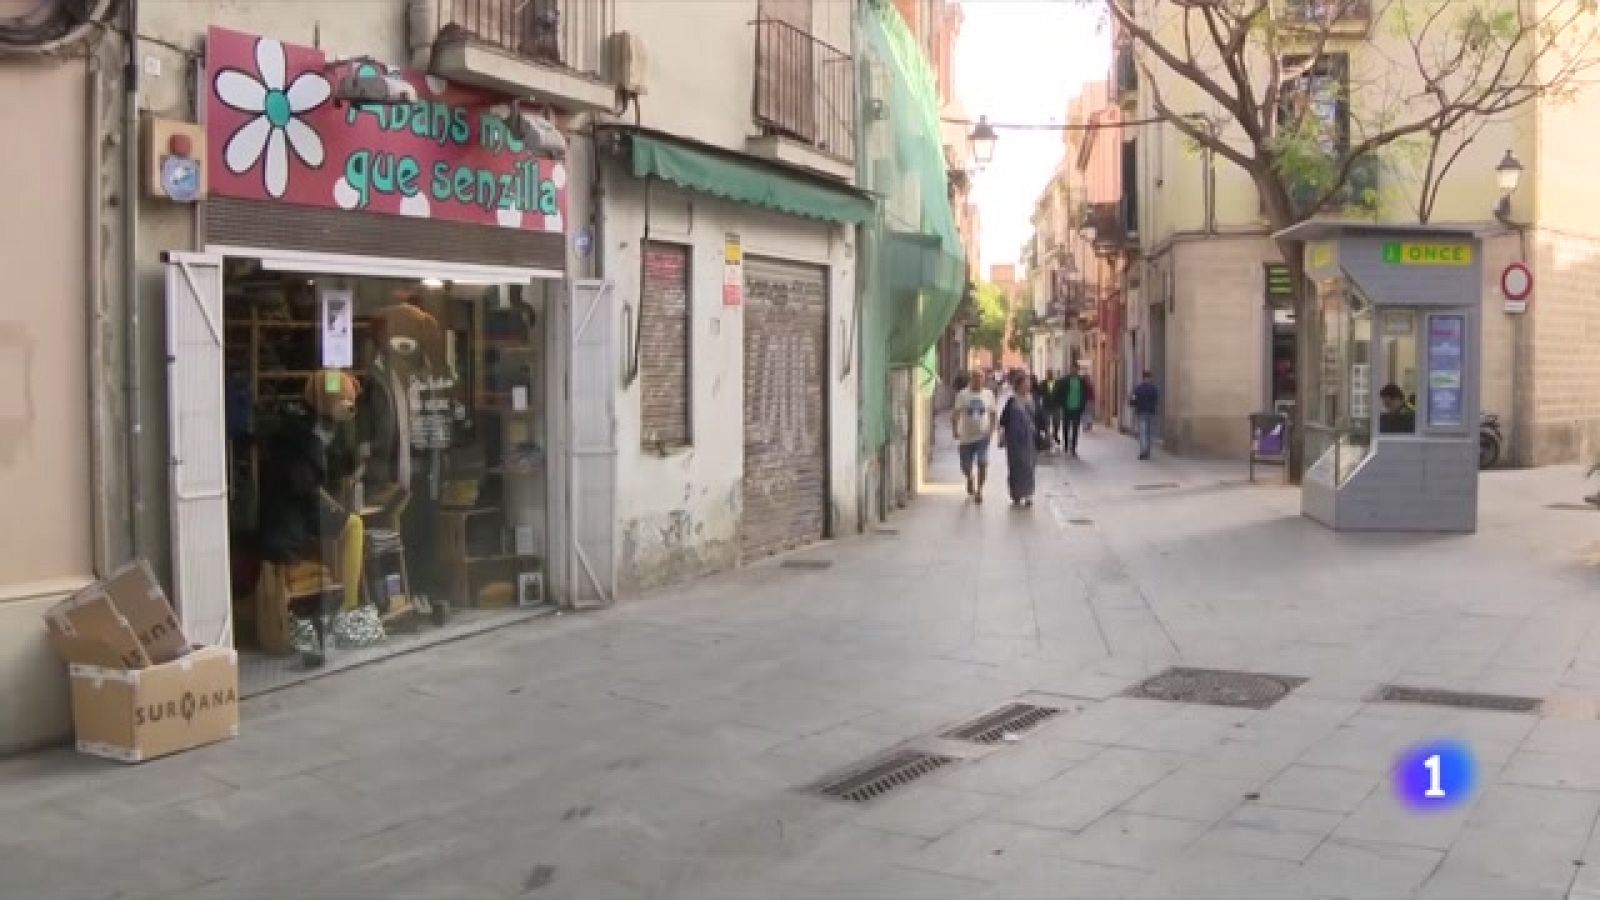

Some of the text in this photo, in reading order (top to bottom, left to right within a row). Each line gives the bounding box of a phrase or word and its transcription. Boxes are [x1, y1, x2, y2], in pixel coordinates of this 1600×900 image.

[345, 150, 558, 215] que senzilla
[1408, 246, 1464, 262] ONCE
